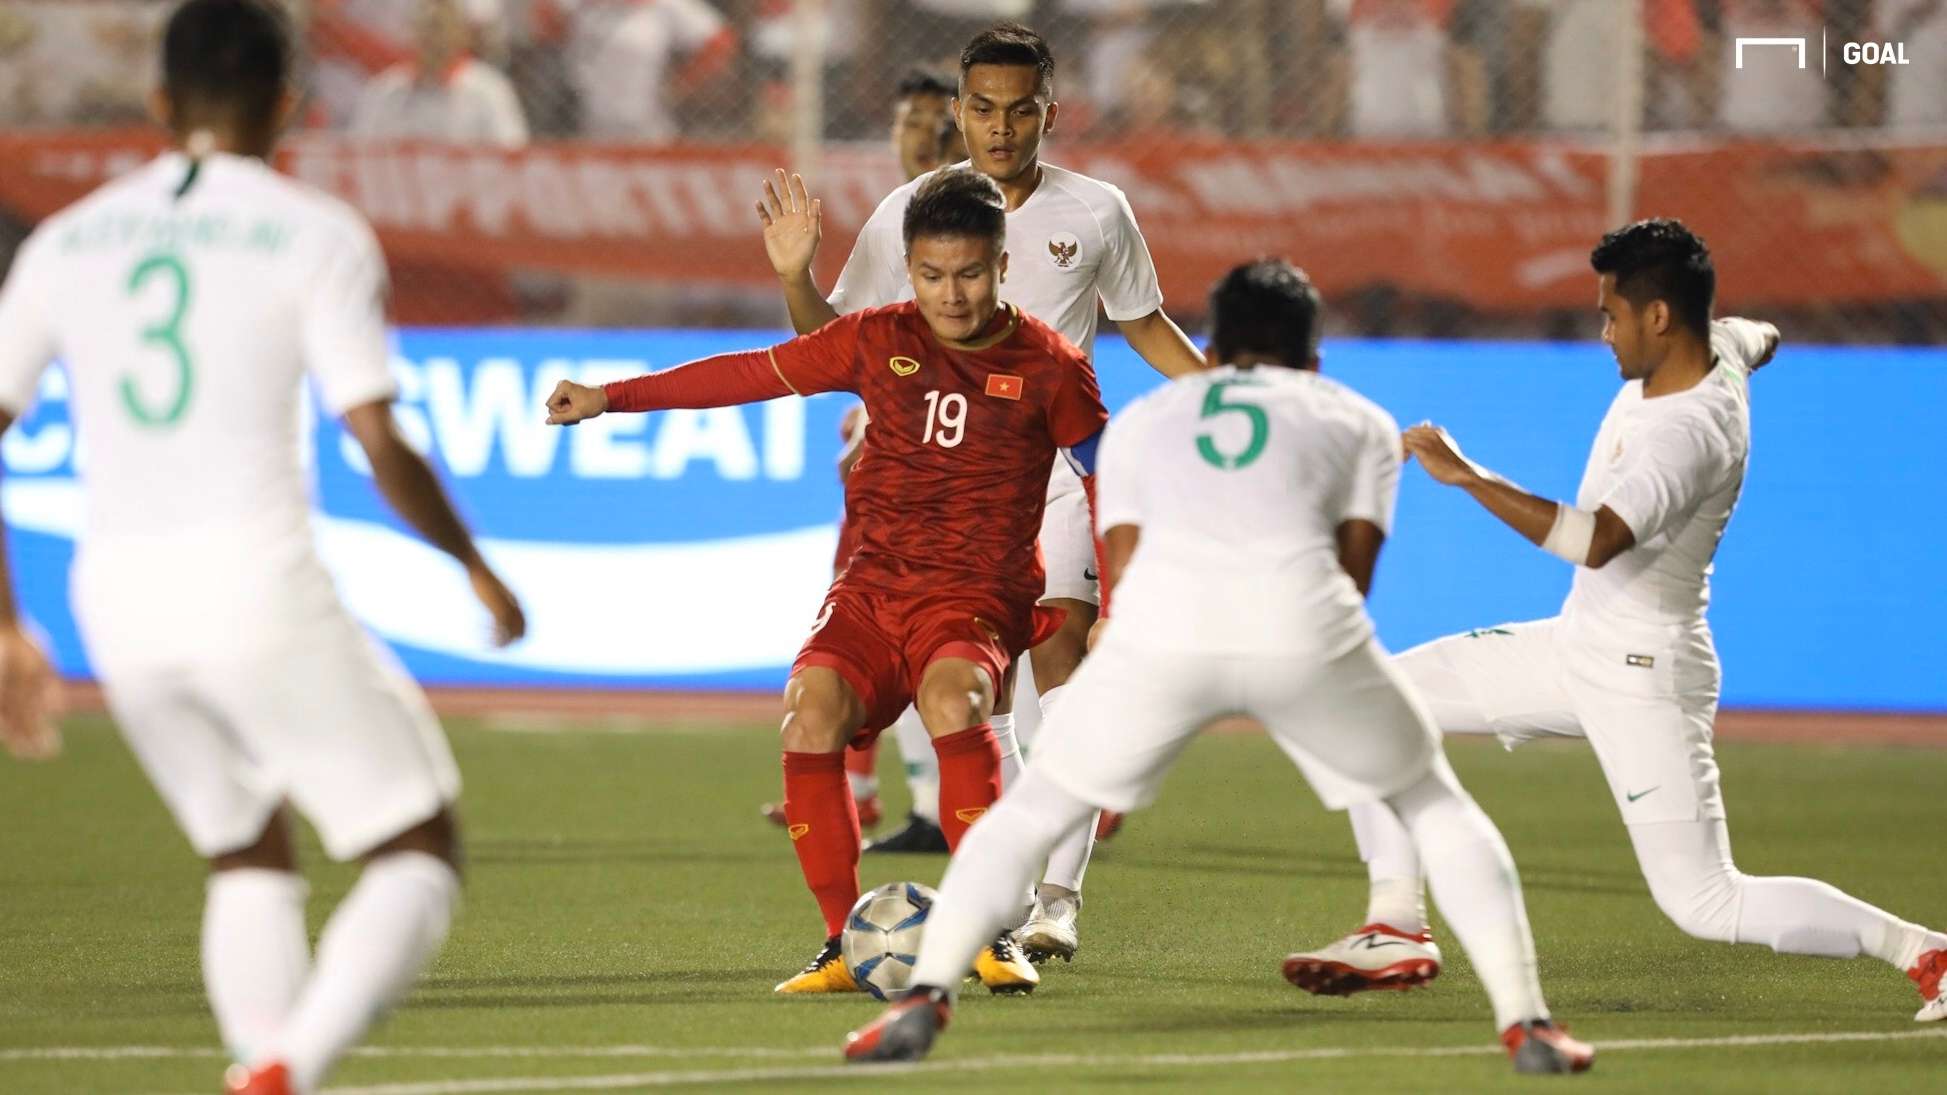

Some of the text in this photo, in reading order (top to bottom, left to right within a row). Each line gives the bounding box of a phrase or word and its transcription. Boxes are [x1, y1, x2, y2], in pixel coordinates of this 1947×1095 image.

[118, 254, 195, 427] 3
[922, 390, 968, 448] 19
[1195, 379, 1270, 471] 5
